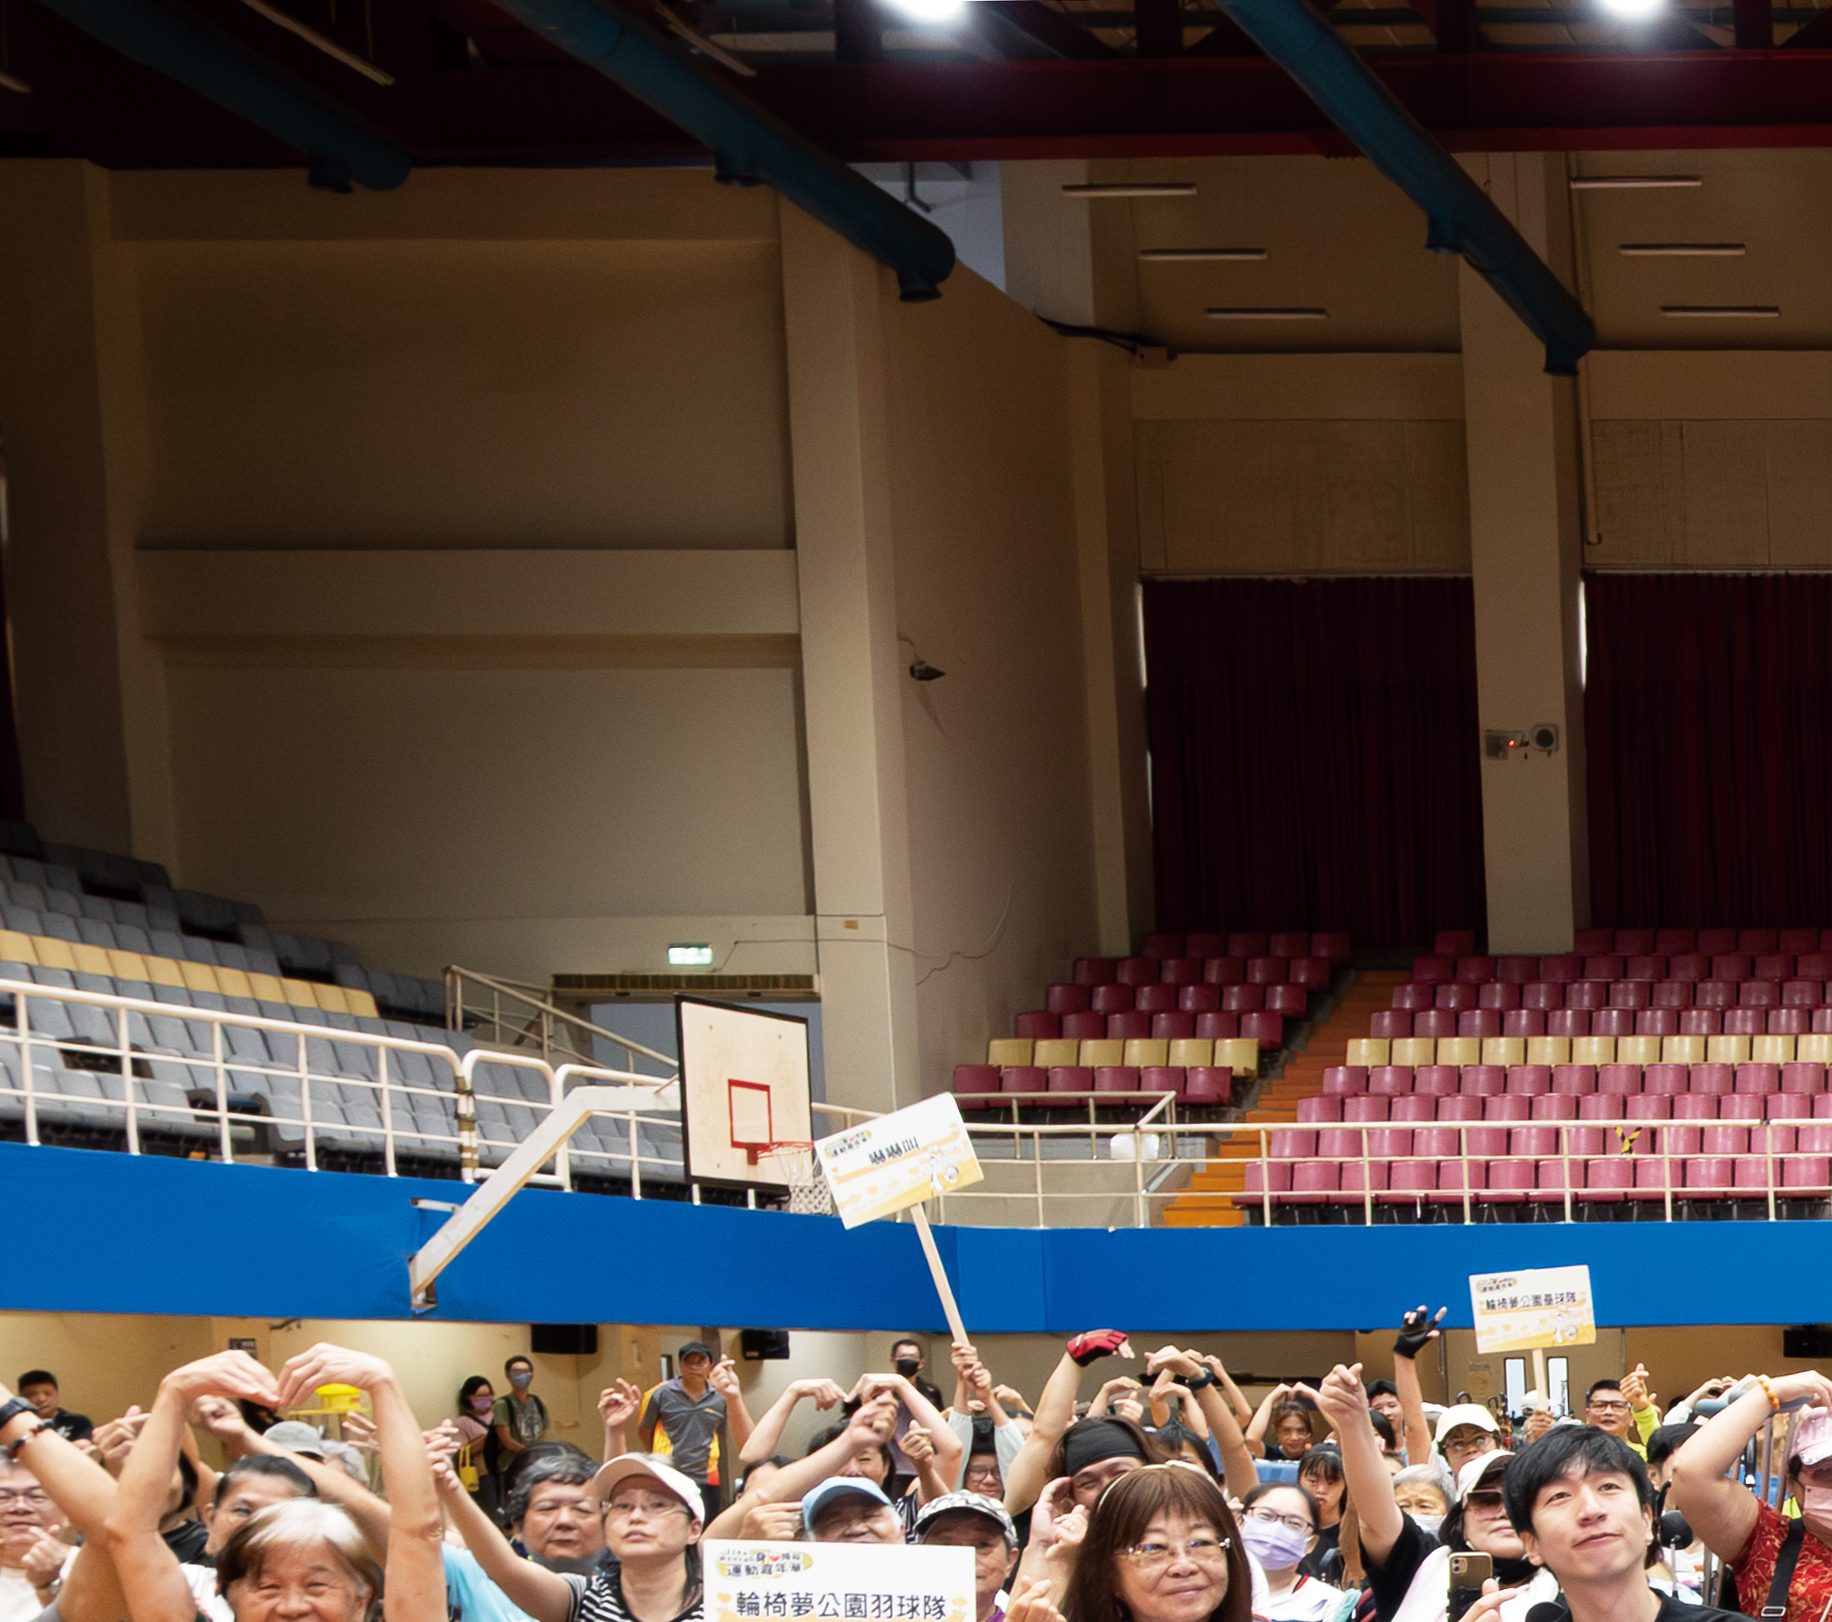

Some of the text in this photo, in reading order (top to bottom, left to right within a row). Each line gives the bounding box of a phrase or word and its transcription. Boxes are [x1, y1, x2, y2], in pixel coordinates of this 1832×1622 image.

[736, 1591, 947, 1620] 輪椅夢公園羽球隊
